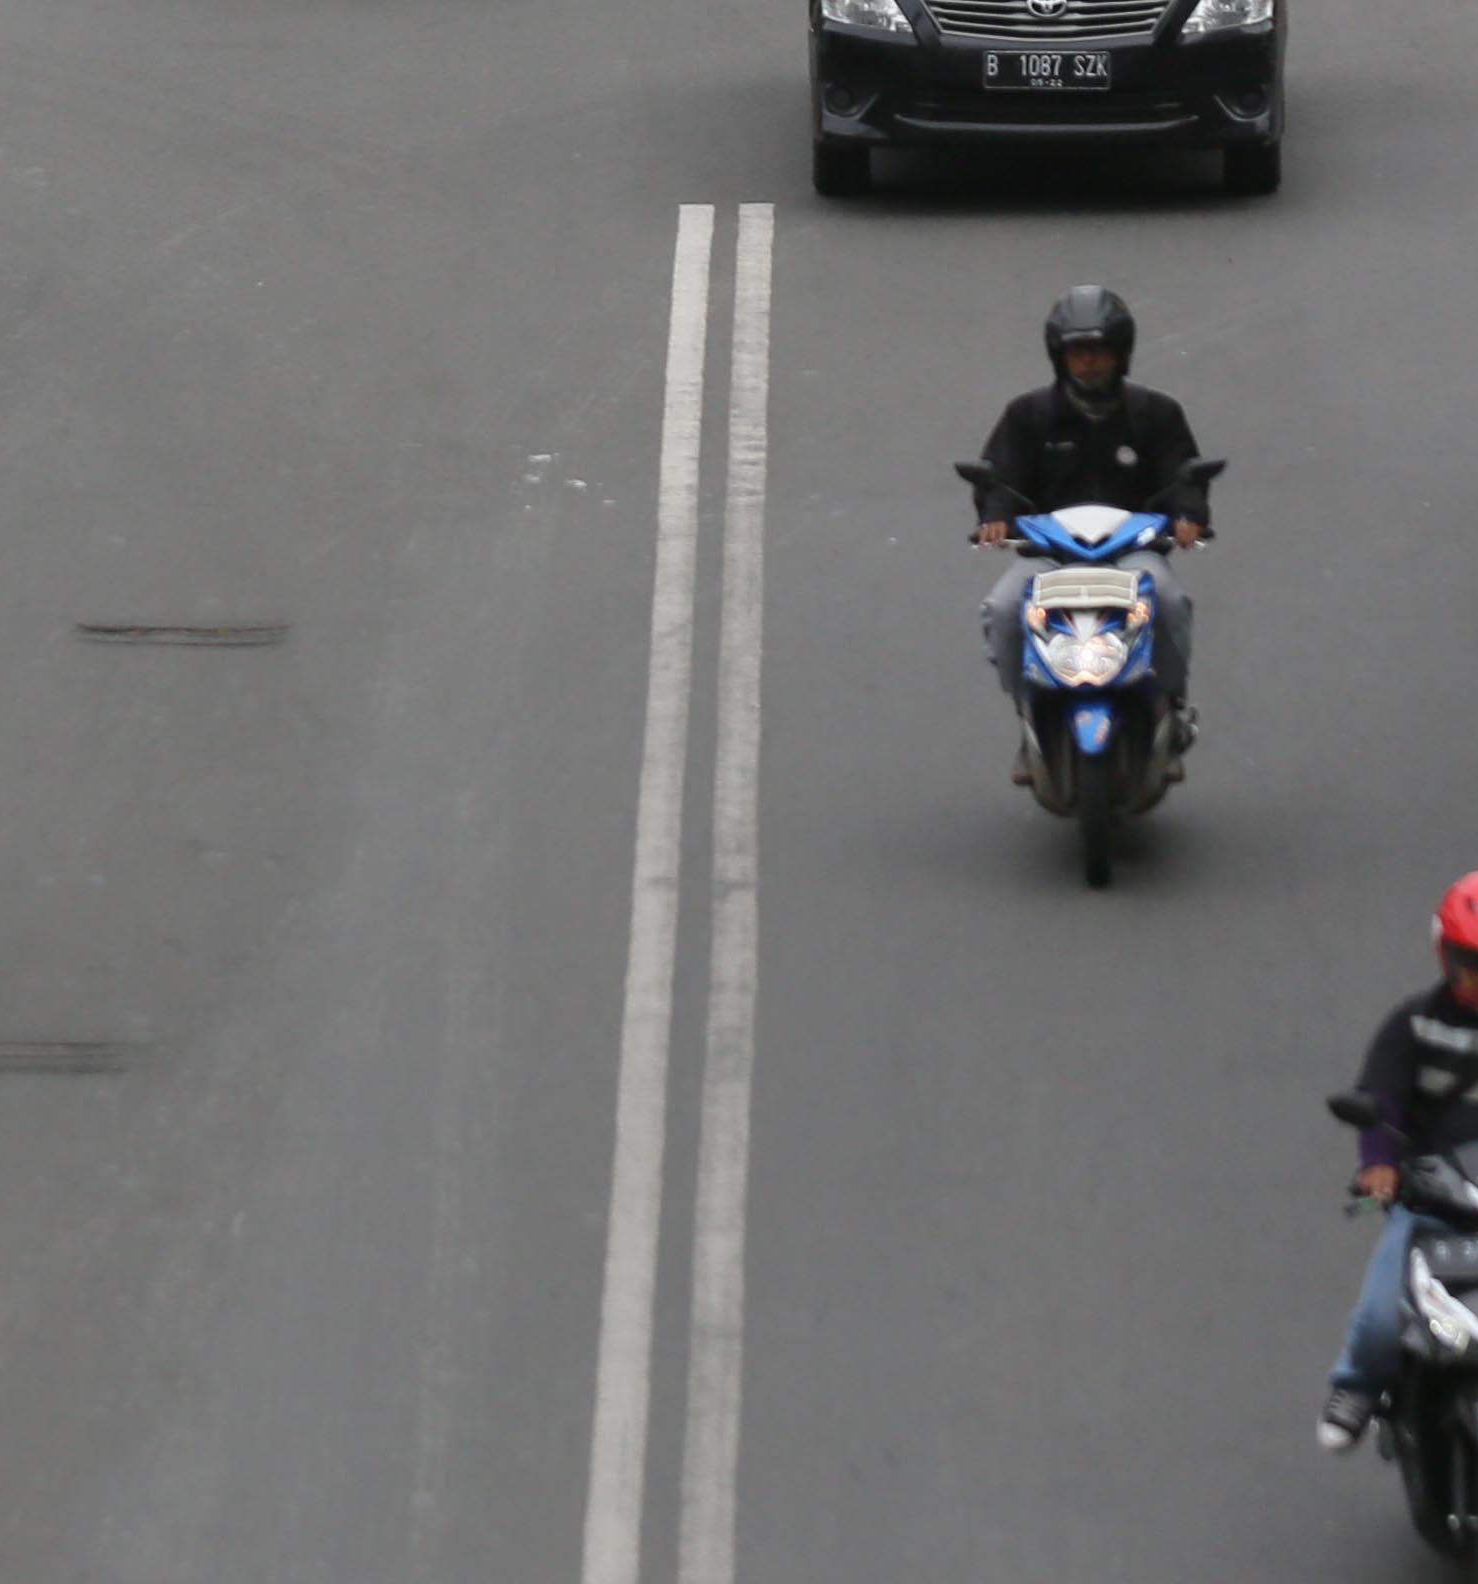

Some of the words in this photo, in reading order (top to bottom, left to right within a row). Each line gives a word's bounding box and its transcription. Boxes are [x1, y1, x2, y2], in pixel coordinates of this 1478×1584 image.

[987, 55, 999, 77] B
[1019, 55, 1063, 77] 1087
[1073, 55, 1108, 77] SZK
